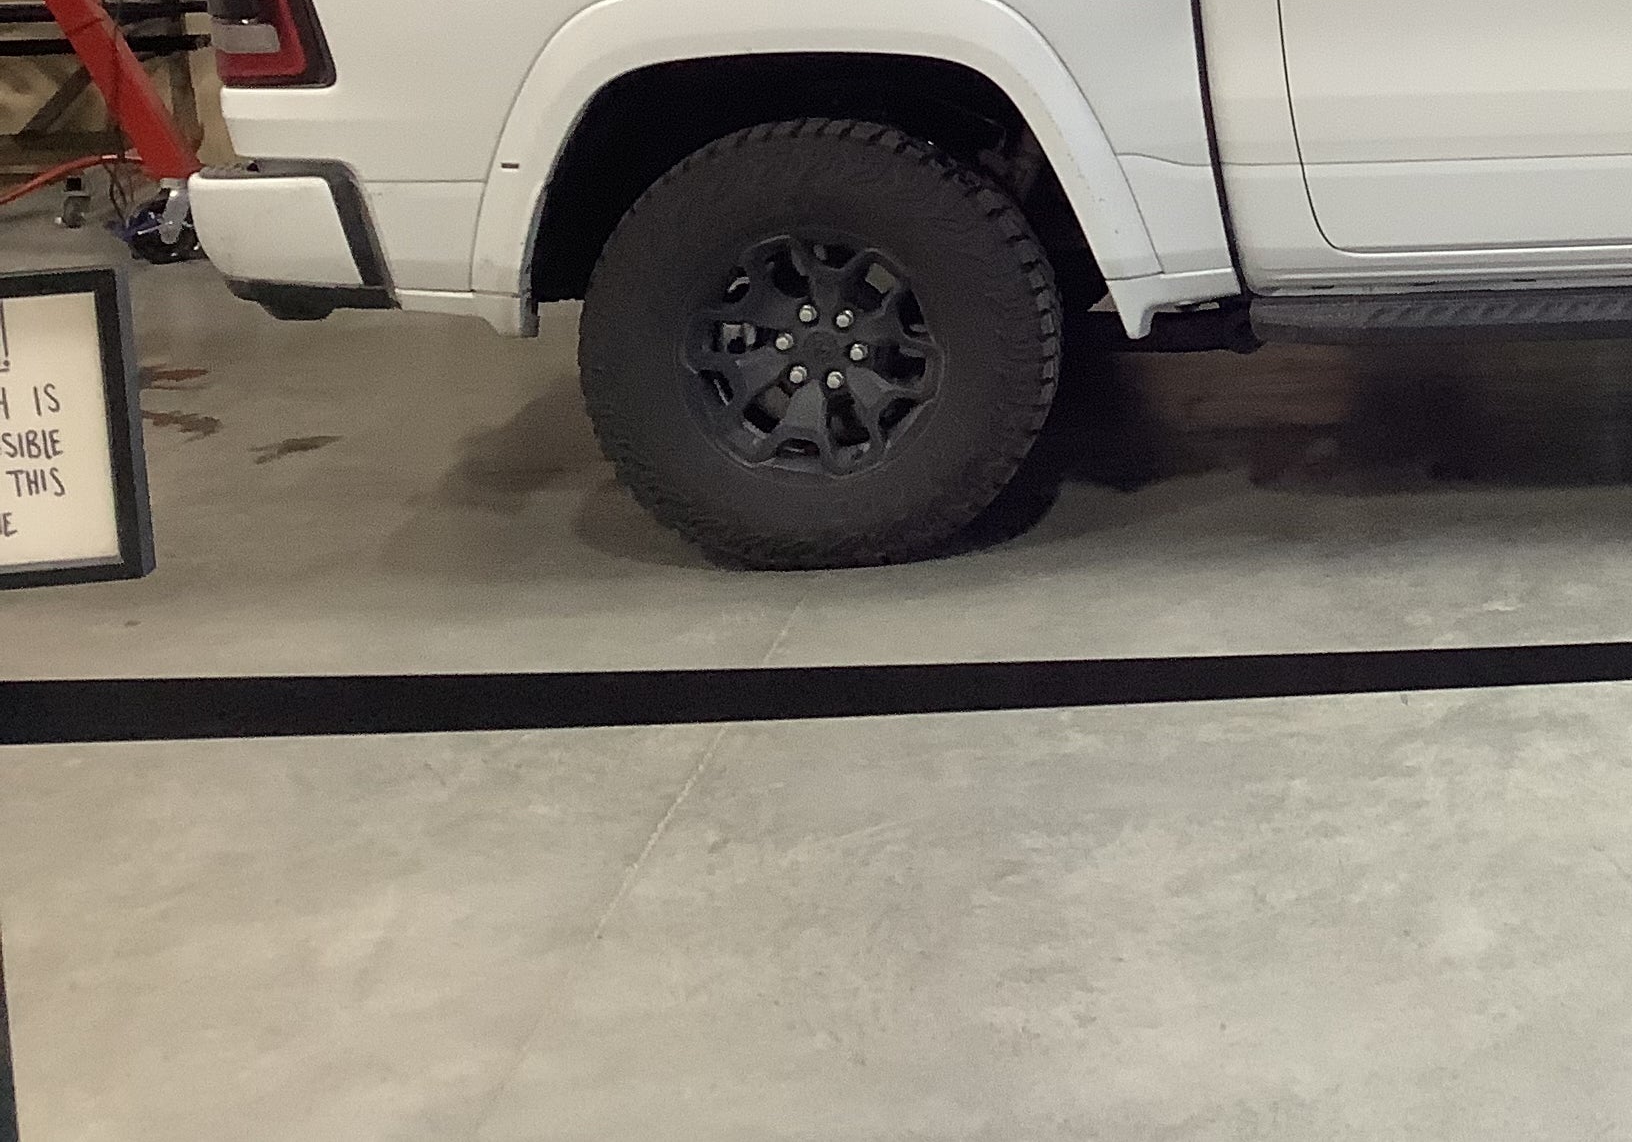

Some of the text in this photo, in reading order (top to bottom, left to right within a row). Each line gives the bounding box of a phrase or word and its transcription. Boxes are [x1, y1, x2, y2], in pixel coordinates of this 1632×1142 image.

[33, 383, 61, 417] IS
[0, 429, 64, 460] SIBLE
[5, 467, 66, 498] THIS
[0, 512, 18, 538] E
